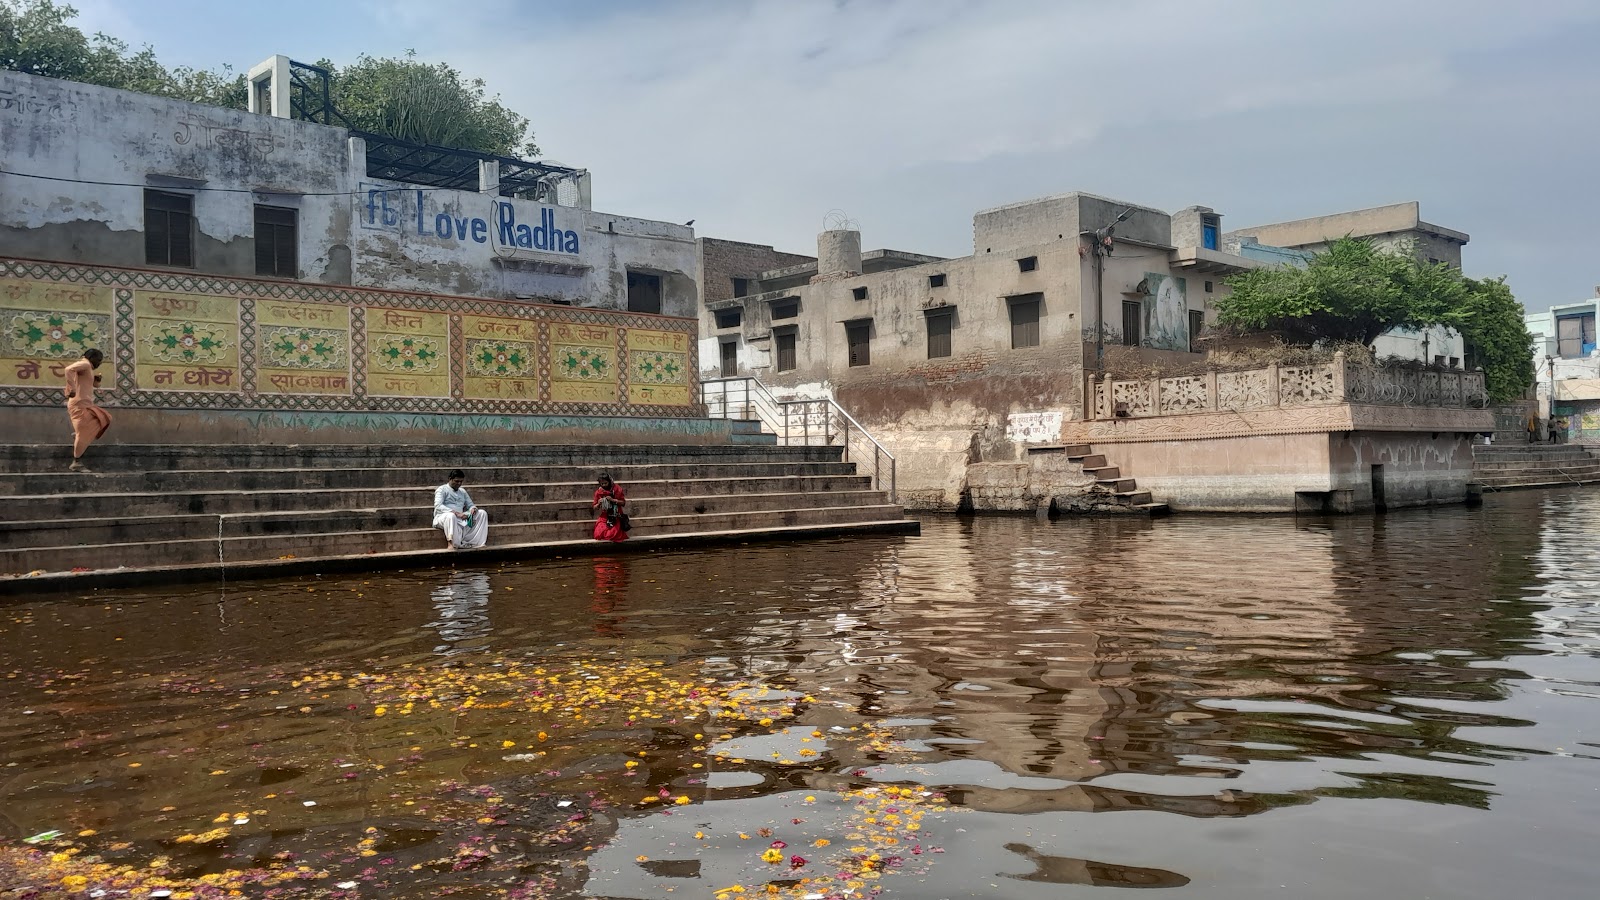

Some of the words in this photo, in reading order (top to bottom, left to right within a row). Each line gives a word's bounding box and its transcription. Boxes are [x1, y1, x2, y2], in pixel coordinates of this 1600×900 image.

[417, 190, 487, 244] Love
[499, 201, 579, 254] Radha
[153, 369, 177, 385] न
